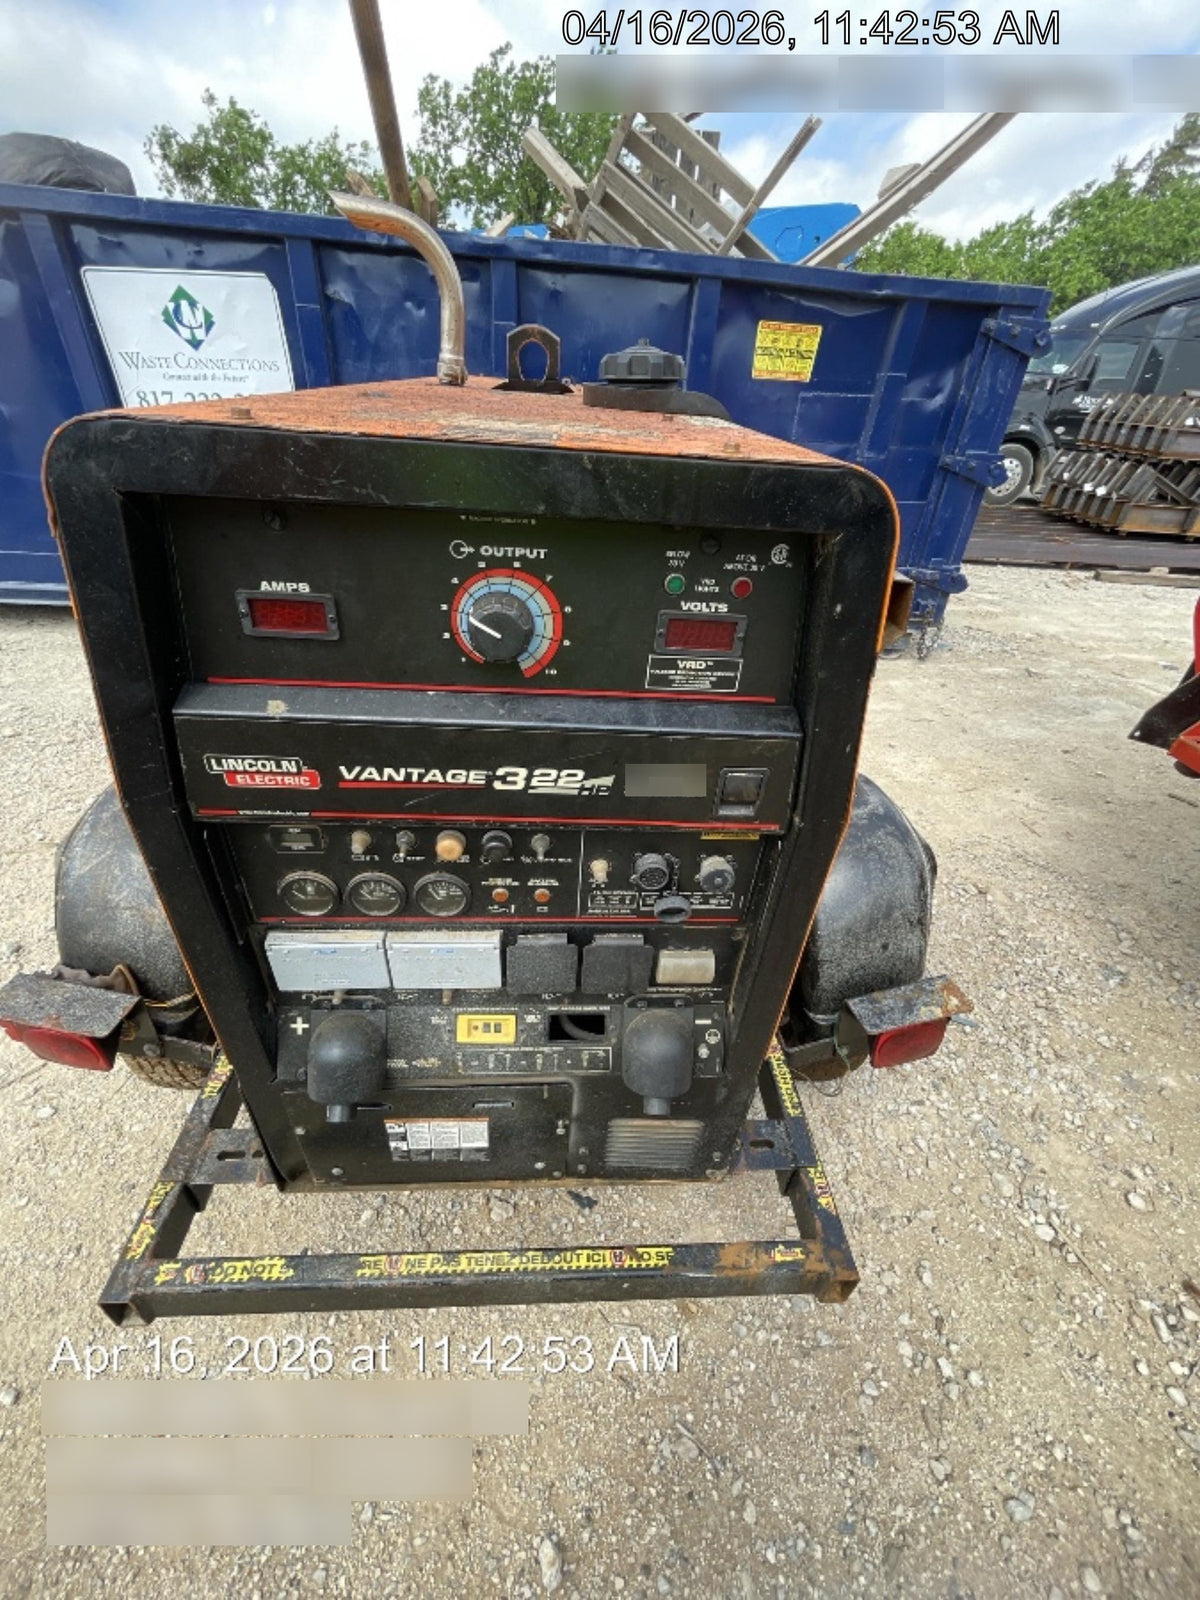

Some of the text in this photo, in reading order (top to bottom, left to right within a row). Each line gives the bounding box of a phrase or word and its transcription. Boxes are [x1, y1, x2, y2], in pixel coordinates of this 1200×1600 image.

[480, 545, 548, 559] OUTPUT
[260, 581, 310, 593] AMPS
[680, 601, 728, 612] VOLTS
[210, 758, 297, 773] LINCOLN
[235, 774, 311, 786] ELECTRIC
[339, 766, 585, 790] VANTAGE 322
